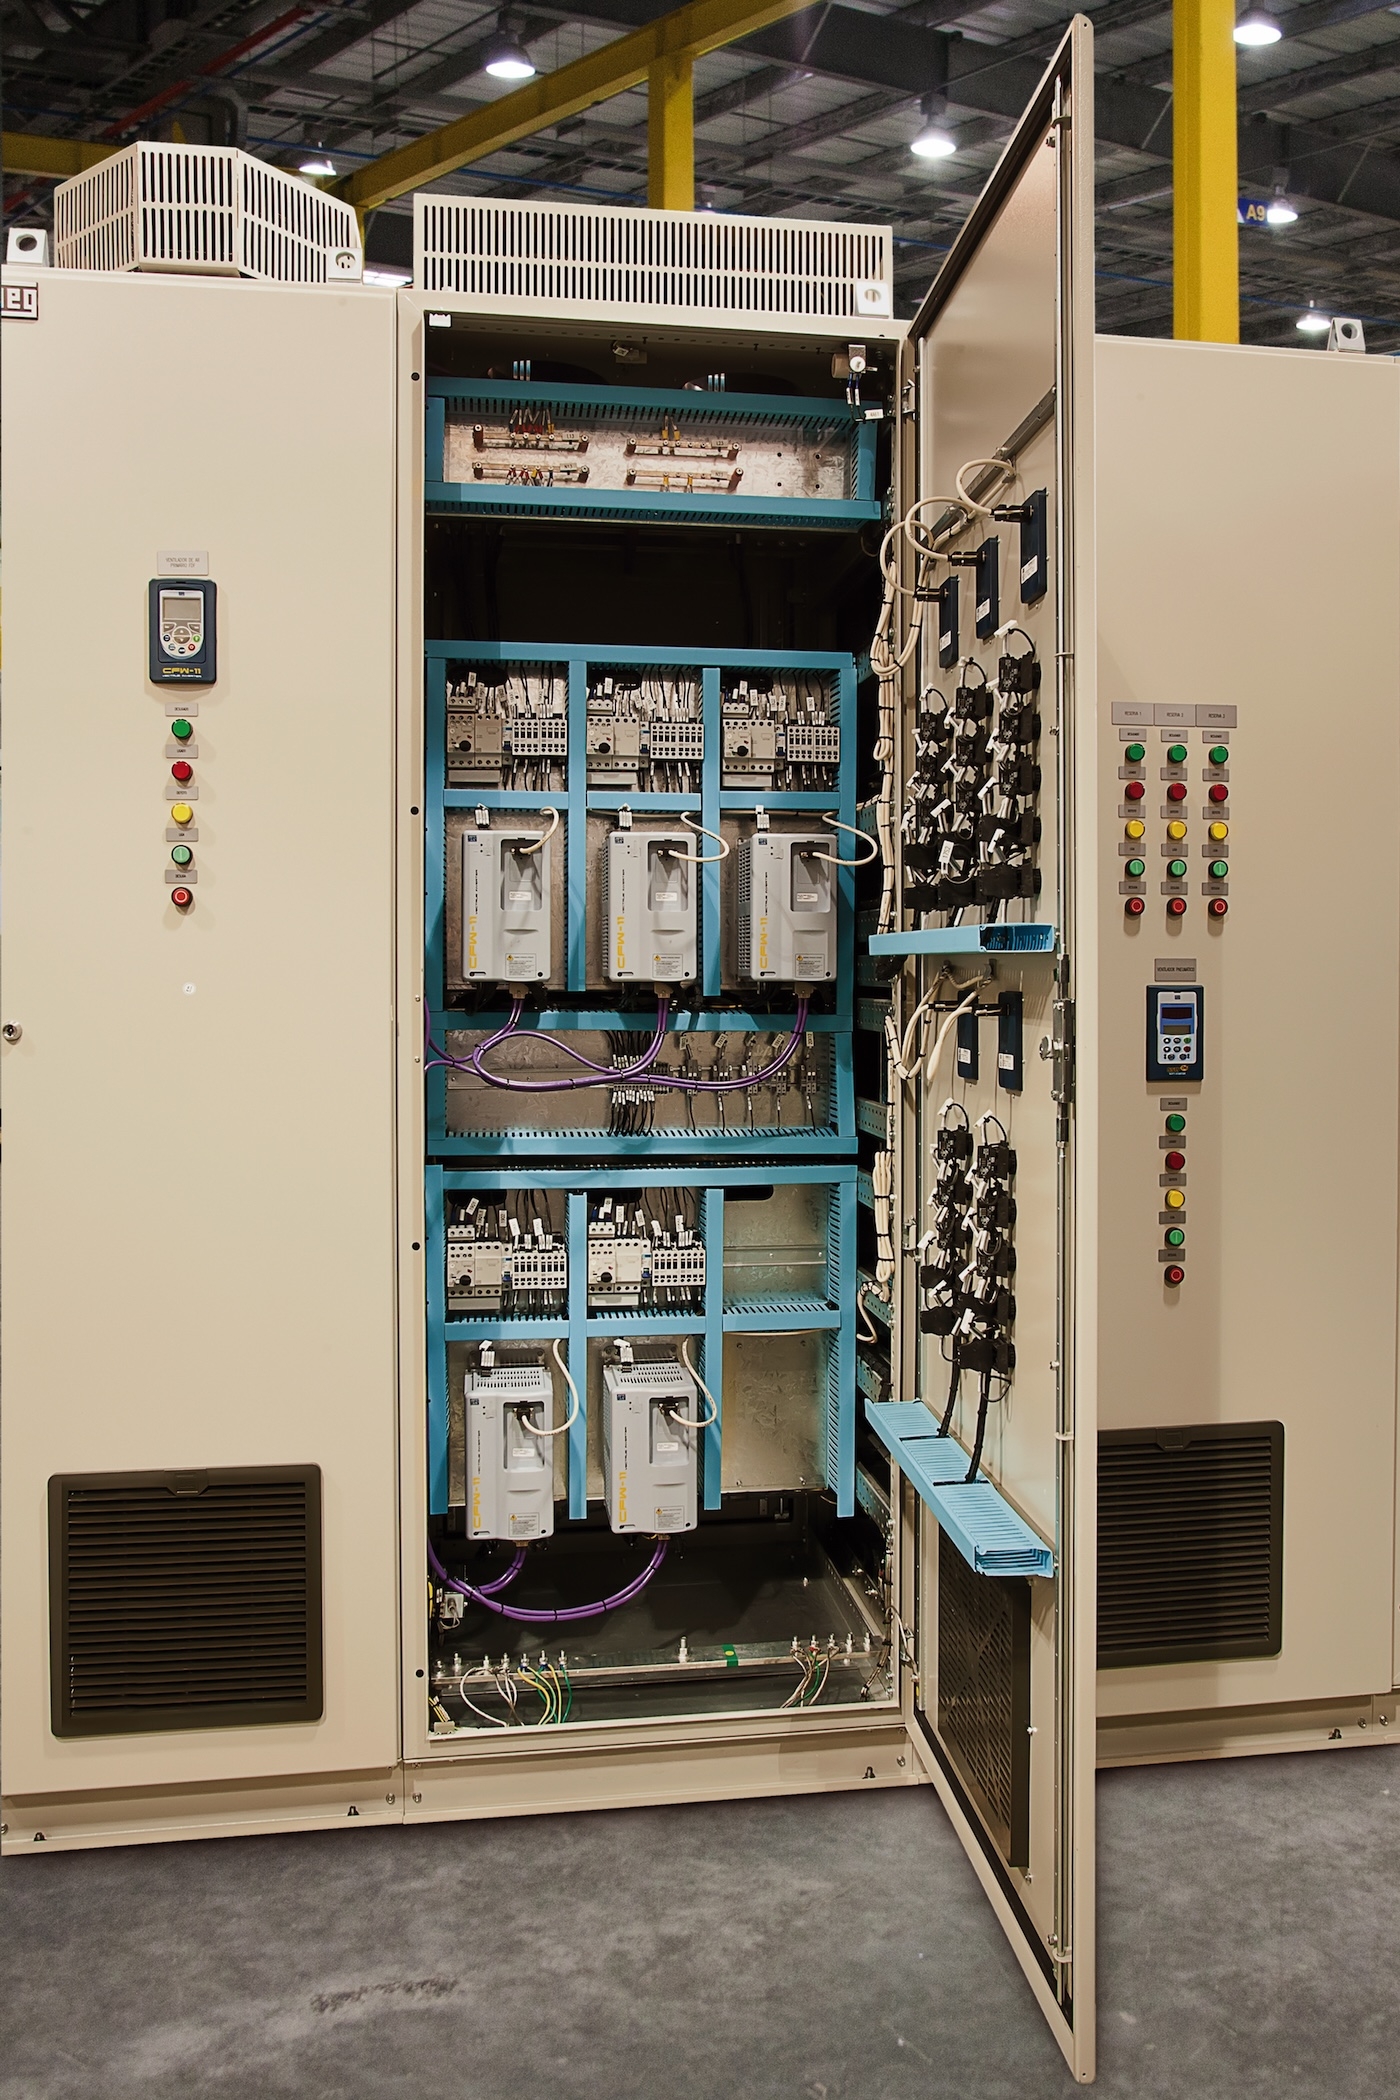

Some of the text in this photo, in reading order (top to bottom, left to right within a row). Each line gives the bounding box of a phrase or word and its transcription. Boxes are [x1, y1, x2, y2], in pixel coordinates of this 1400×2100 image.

[1246, 204, 1266, 221] A9
[469, 915, 477, 969] CFW-11
[616, 916, 625, 968] CFW-11
[759, 917, 768, 969] CFW-11
[473, 1477, 481, 1529] CFW-11
[618, 1471, 627, 1523] CFW-11
